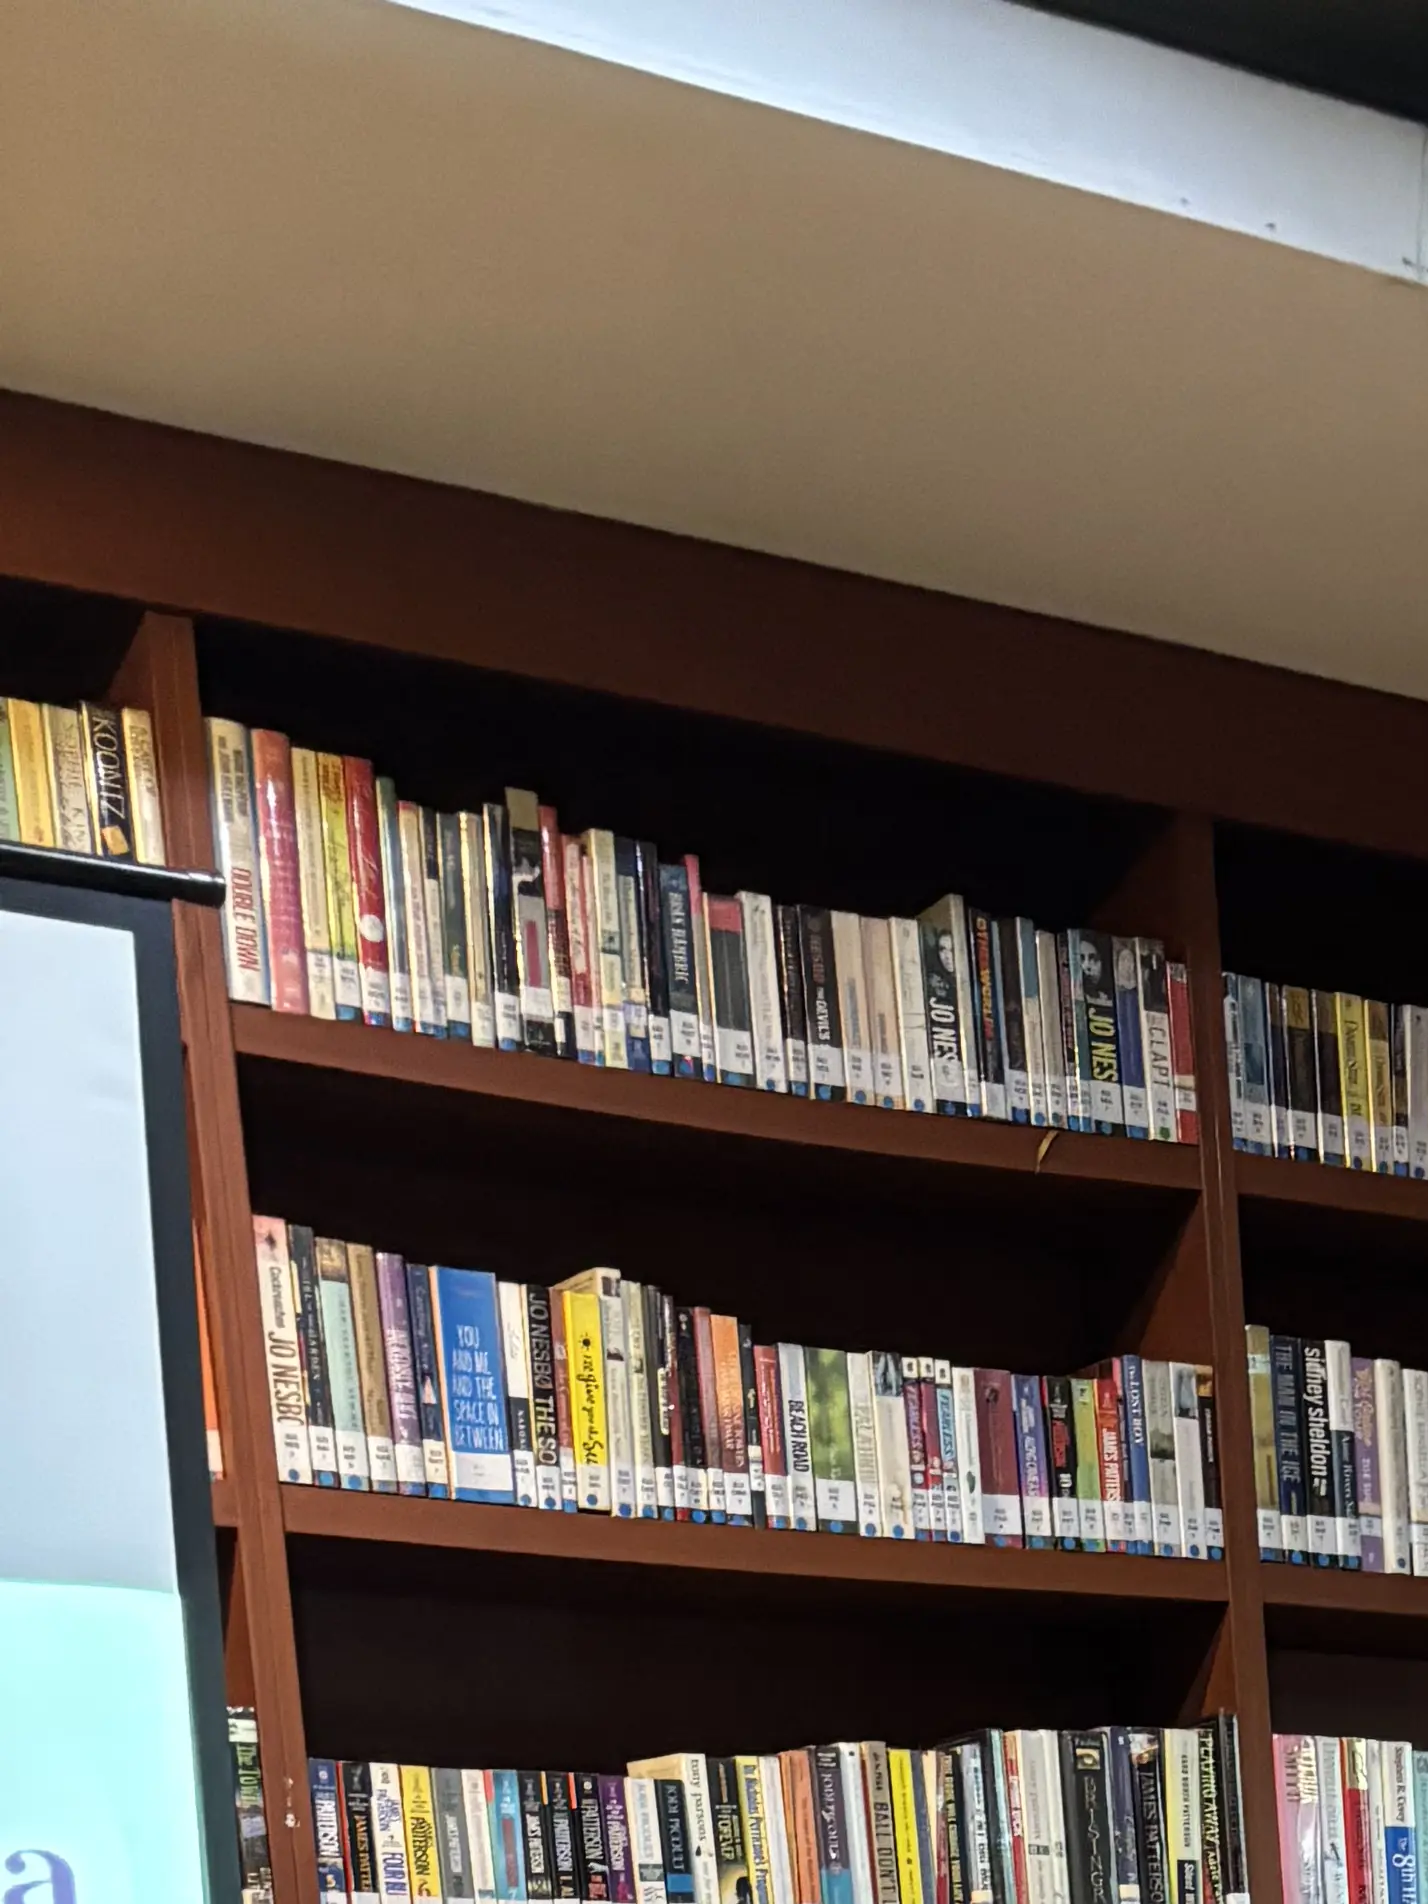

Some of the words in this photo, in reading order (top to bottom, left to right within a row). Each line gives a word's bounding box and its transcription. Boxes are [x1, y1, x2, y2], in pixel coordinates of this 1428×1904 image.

[232, 868, 258, 920] DOUBLE
[238, 928, 261, 971] DOWN
[929, 997, 953, 1021] JO
[1088, 1008, 1113, 1036] JO
[1091, 1042, 1118, 1082] NES
[1149, 1027, 1170, 1088] CLAPT
[529, 1293, 548, 1319] JO
[268, 1331, 298, 1358] JO
[1276, 1346, 1294, 1370] THE
[1278, 1374, 1296, 1405] MAN
[1303, 1347, 1327, 1403] sidney
[536, 1396, 554, 1434] THE
[788, 1399, 805, 1439] BEACH
[1279, 1410, 1298, 1425] IN
[538, 1436, 557, 1465] SO
[792, 1441, 810, 1472] ROAD
[1280, 1432, 1298, 1455] THE
[1306, 1407, 1331, 1475] sheldon
[1103, 1462, 1122, 1501] PATTERS
[1282, 1461, 1301, 1483] ICE
[689, 1759, 705, 1789] tony
[1393, 1746, 1405, 1782] Stephen
[664, 1784, 678, 1814] JODI
[1138, 1772, 1158, 1820] JAMES
[316, 1799, 337, 1856] PATTERSON
[580, 1806, 604, 1859] PATTERSON
[691, 1793, 707, 1841] parsons
[873, 1802, 888, 1837] BALL
[410, 1816, 430, 1876] PATTERSON
[554, 1819, 572, 1872] PATTERSON
[668, 1818, 684, 1872] PICOULT
[383, 1853, 405, 1879] FOUR
[877, 1847, 894, 1896] DON'T
[1391, 1853, 1416, 1883] 8th
